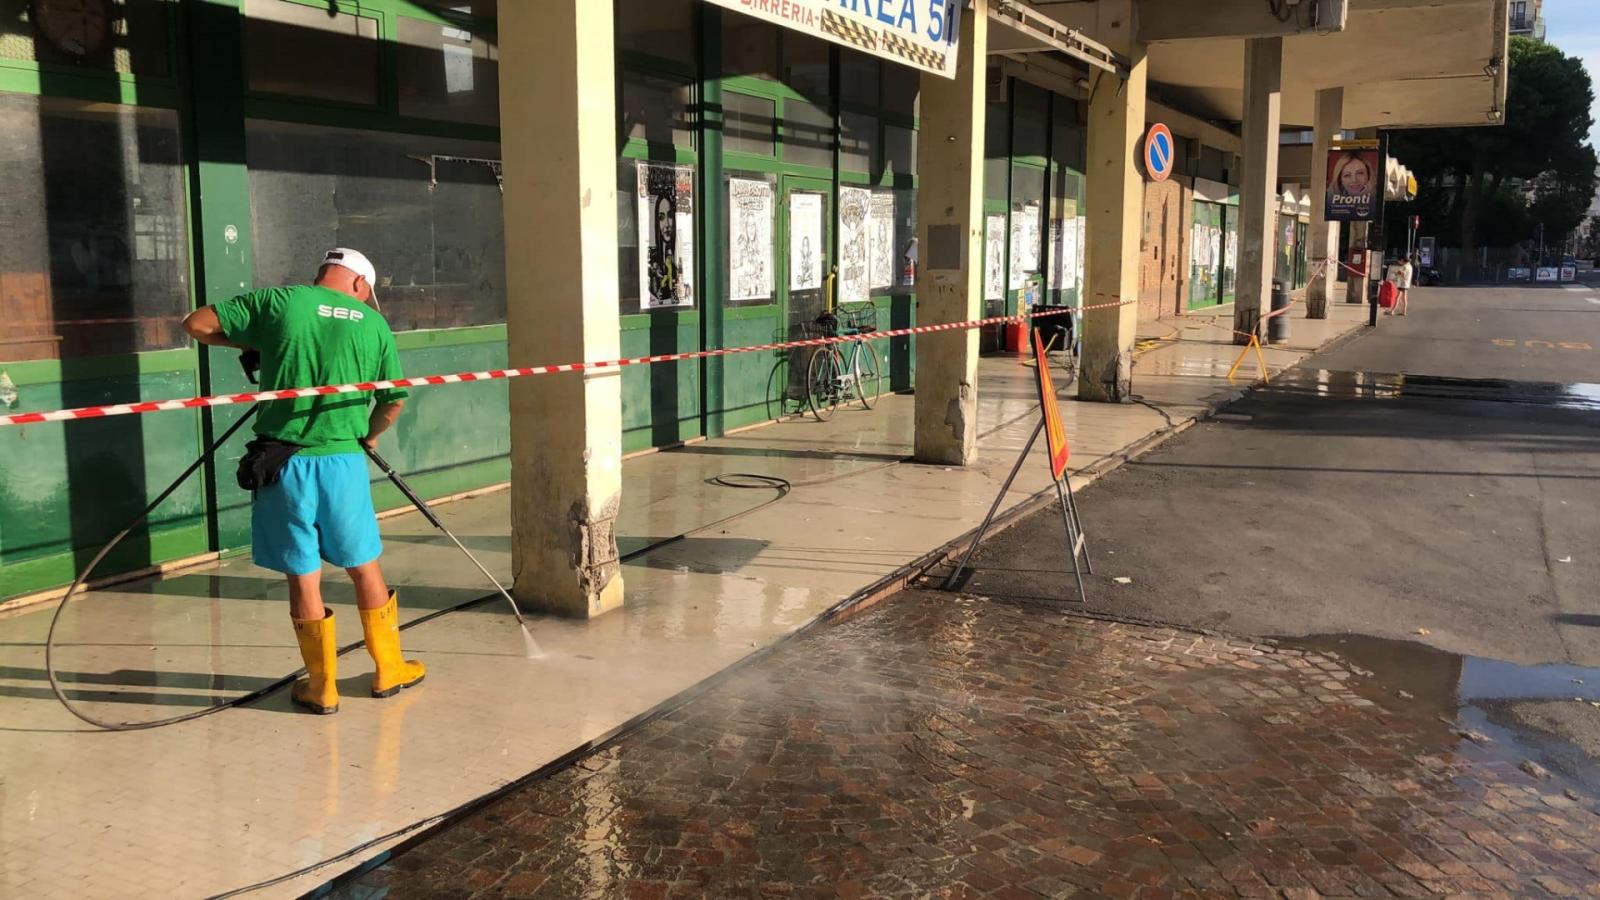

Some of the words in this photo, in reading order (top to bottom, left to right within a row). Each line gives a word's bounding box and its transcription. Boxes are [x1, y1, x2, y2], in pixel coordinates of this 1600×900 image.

[926, 0, 955, 47] 51
[1332, 192, 1371, 204] Pronti
[318, 304, 364, 321] SEP
